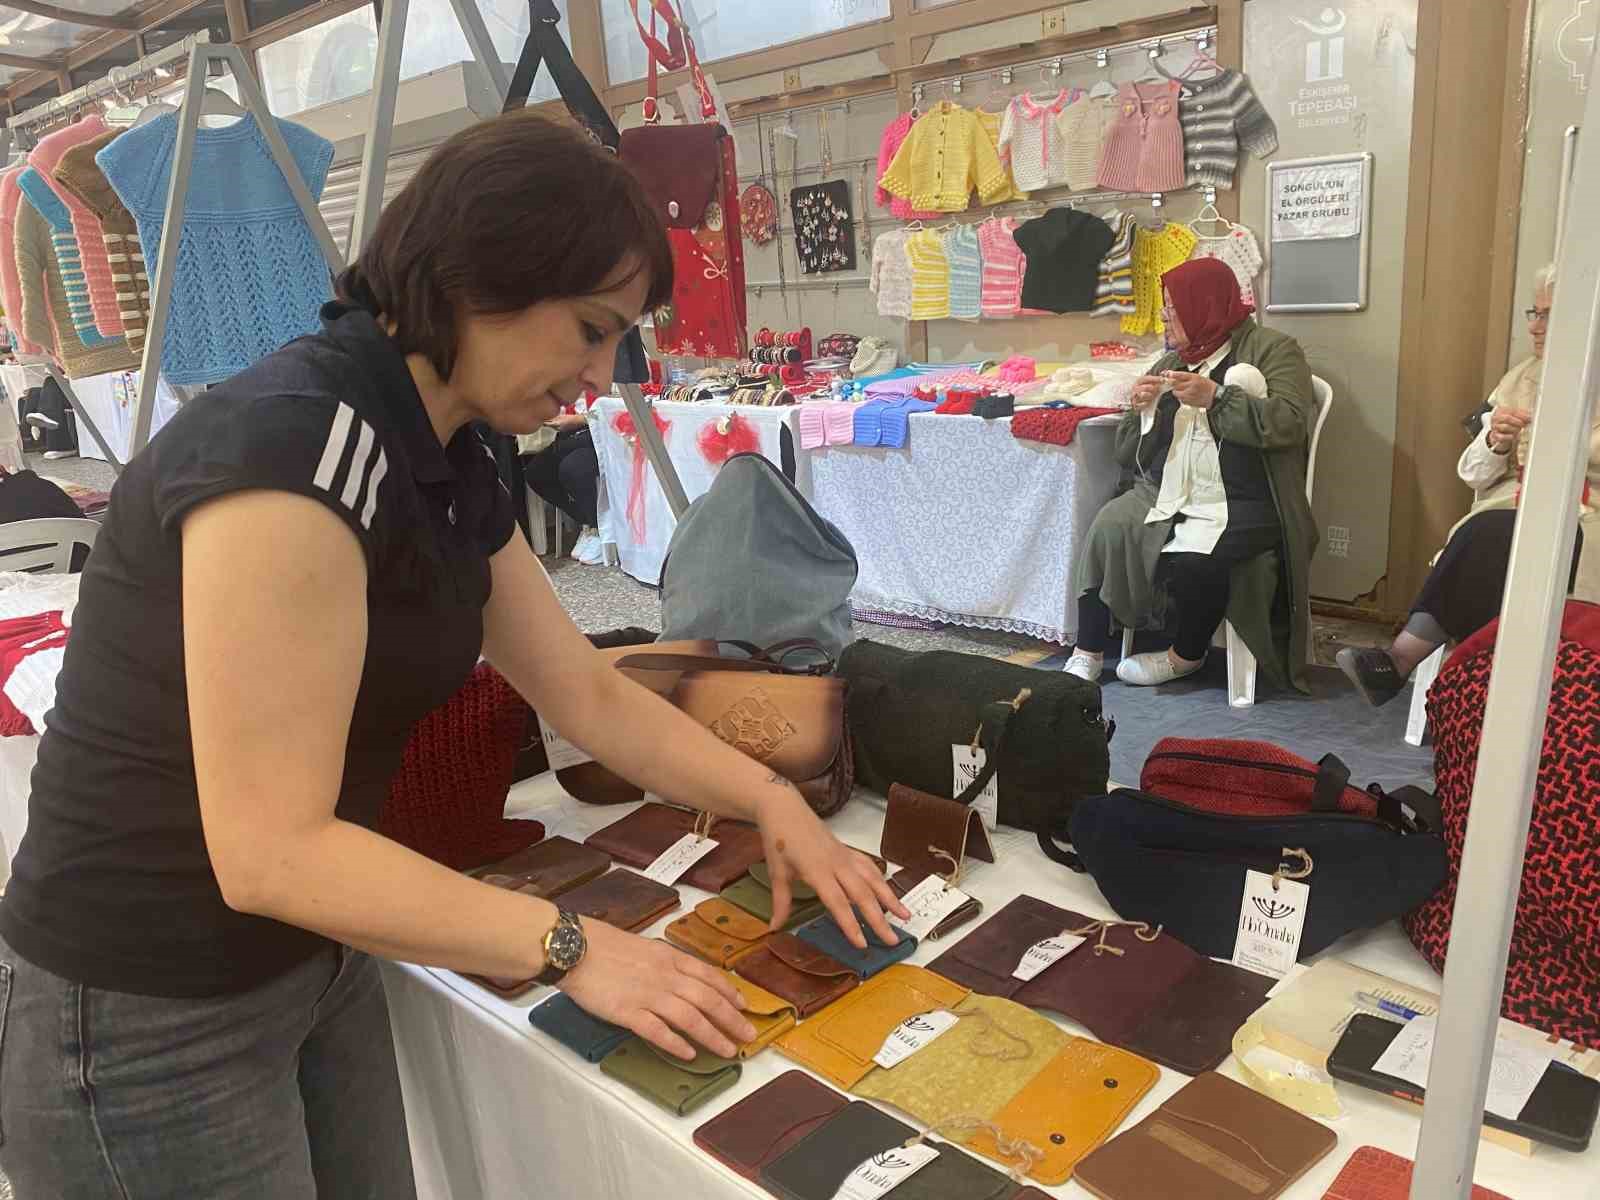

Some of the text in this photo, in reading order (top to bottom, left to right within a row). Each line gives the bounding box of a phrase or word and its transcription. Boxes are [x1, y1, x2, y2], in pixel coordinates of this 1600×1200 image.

[1281, 199, 1293, 207] EL
[1278, 207, 1350, 221] PAZAR GRUBU
